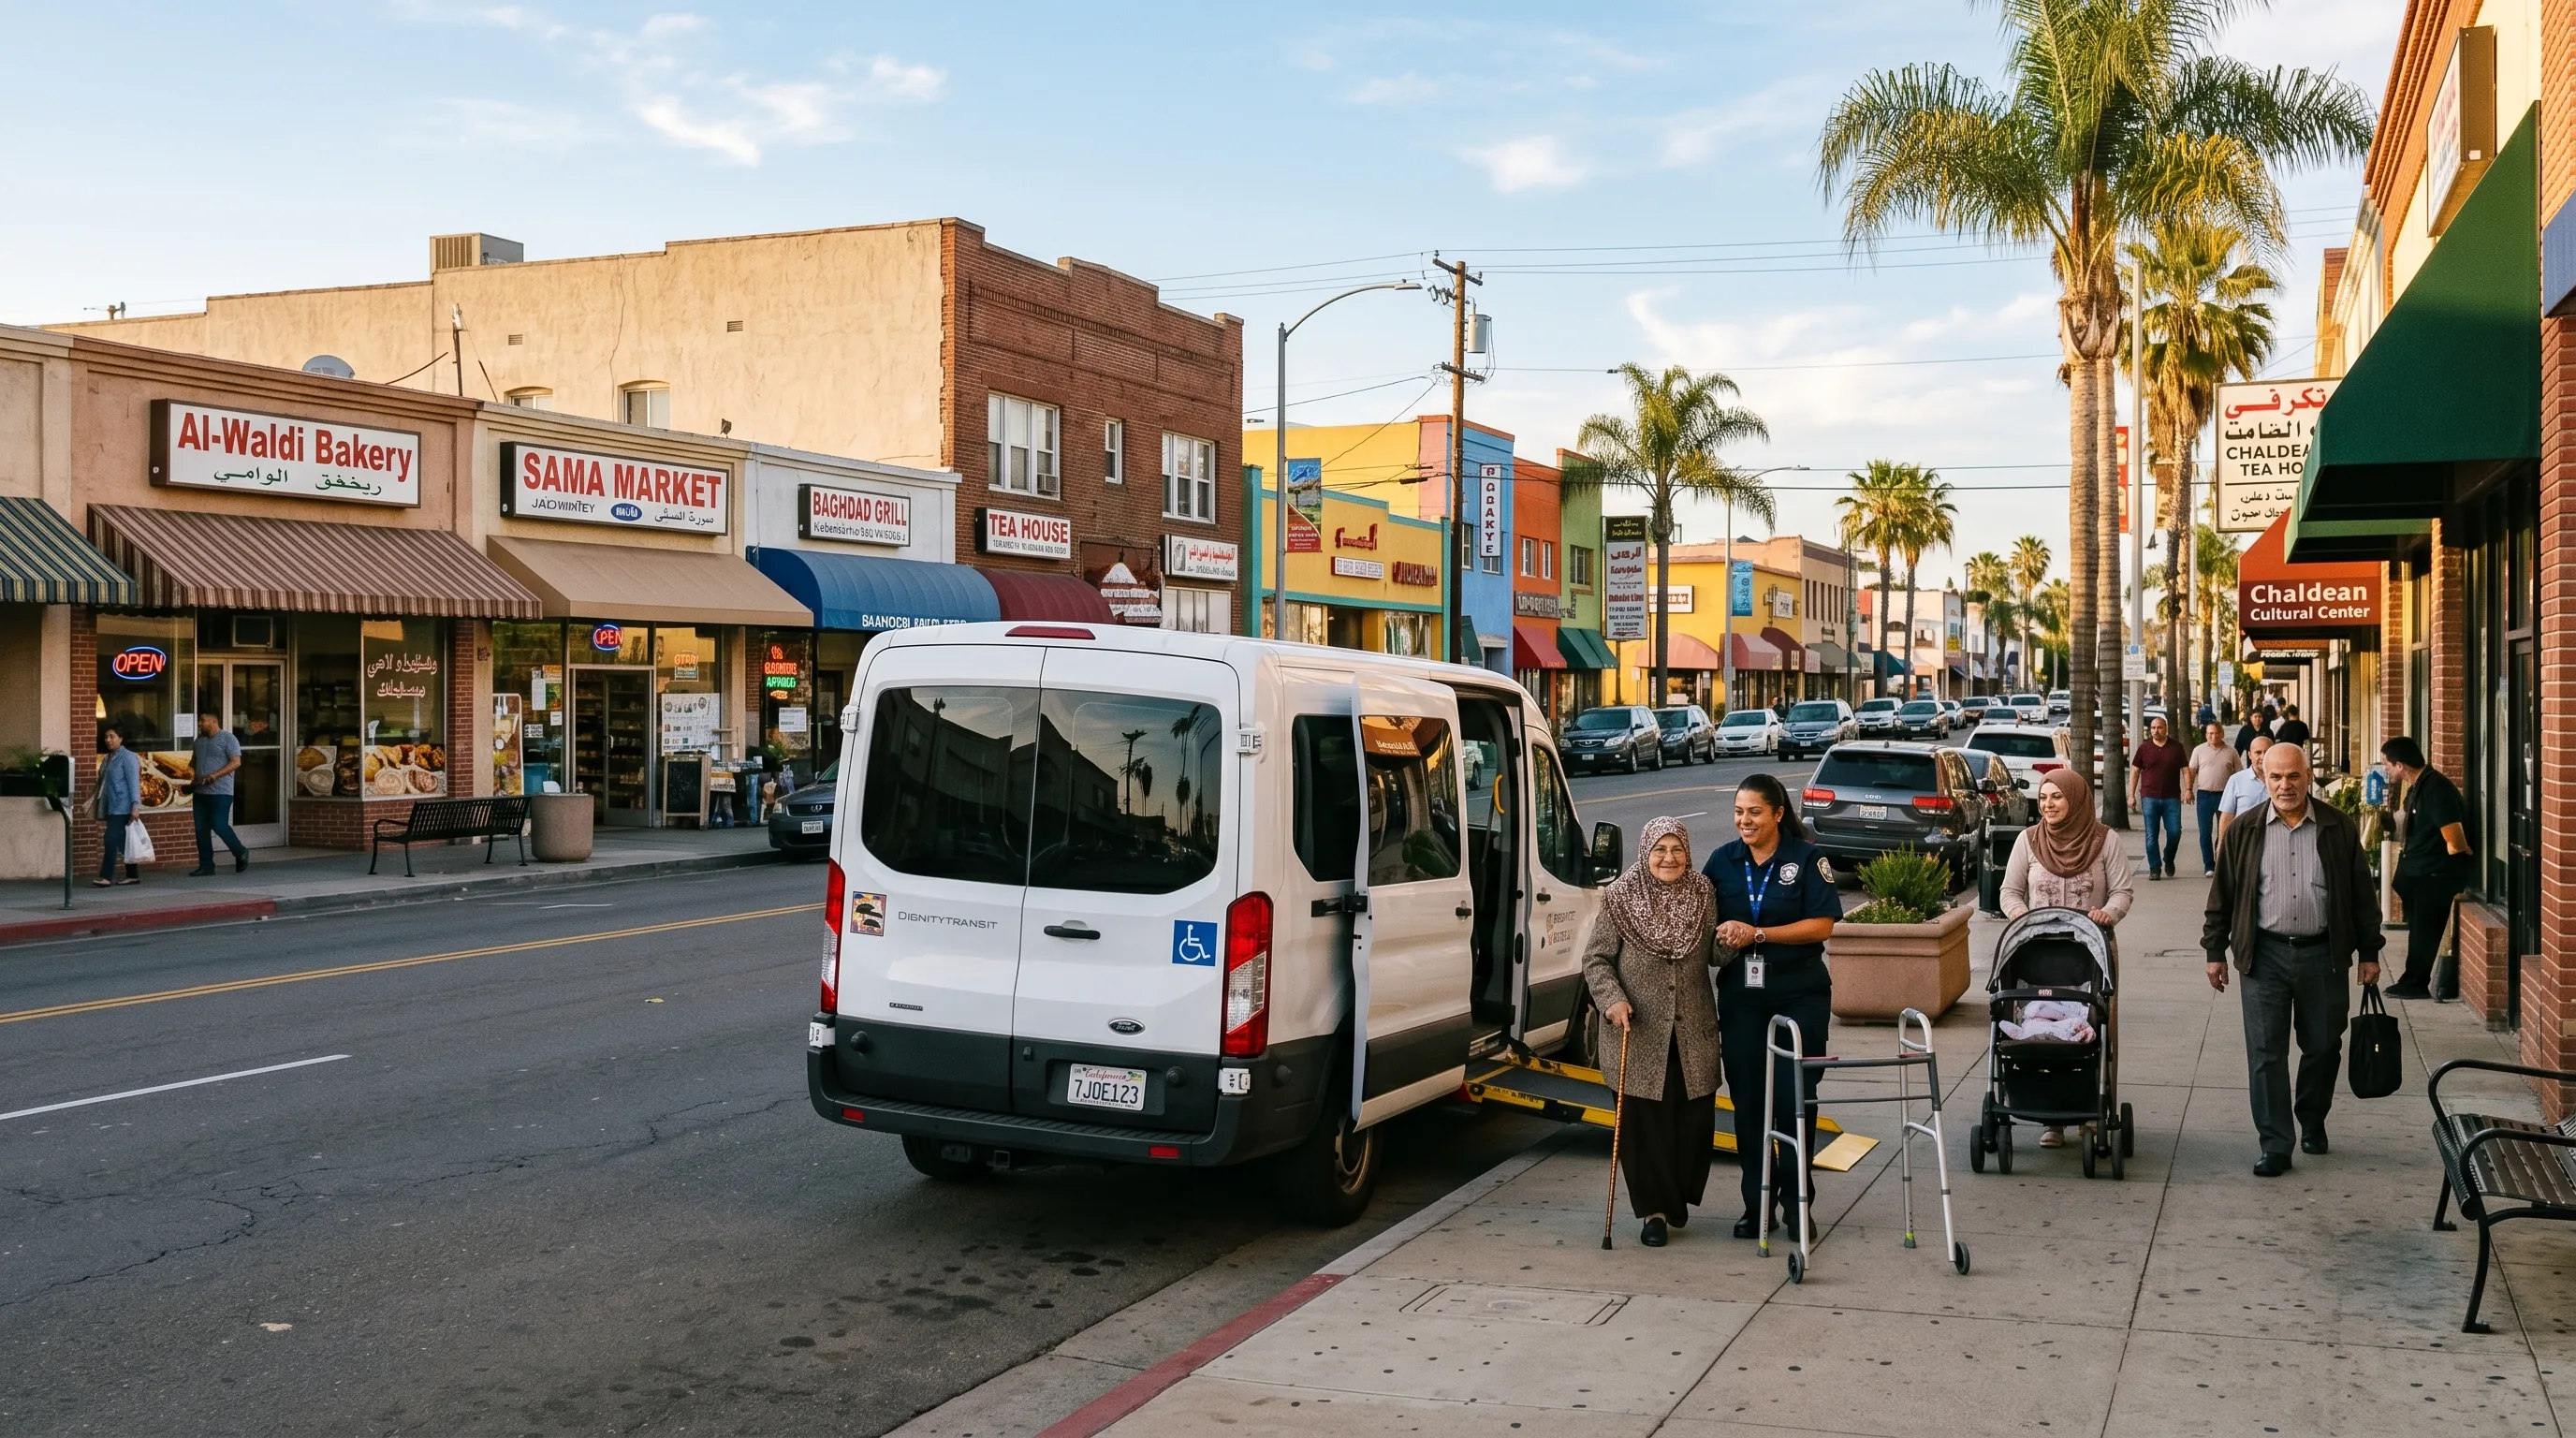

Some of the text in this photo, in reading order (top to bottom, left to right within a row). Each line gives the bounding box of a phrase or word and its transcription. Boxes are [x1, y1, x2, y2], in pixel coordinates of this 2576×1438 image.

[177, 412, 412, 482] Al-Waldi Bakery
[2226, 444, 2309, 460] CHALDEA
[523, 451, 722, 509] SAMA MARKET
[2240, 462, 2304, 477] TEA HO
[812, 491, 907, 526] BAGHDAD GRILL
[988, 513, 1068, 544] TEA HOUSE
[2250, 581, 2367, 604] Chaldean
[2250, 605, 2371, 621] Cultural Center
[115, 653, 163, 672] OPEN
